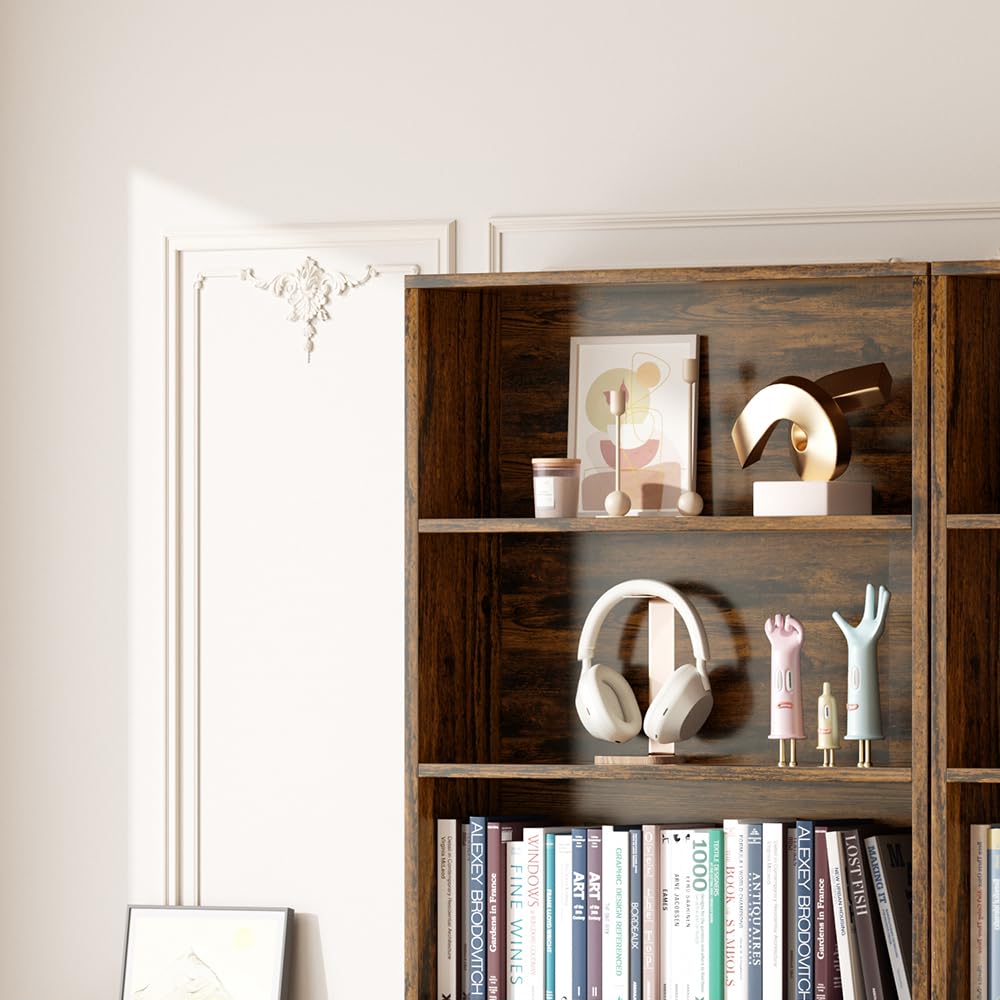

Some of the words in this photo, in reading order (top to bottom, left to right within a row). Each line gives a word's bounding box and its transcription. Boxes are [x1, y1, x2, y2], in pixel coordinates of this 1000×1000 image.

[470, 821, 484, 886] ALEXEY
[528, 834, 539, 908] WINDOWS
[692, 840, 708, 892] 1000
[798, 826, 810, 891] ALEXEY
[845, 835, 862, 877] LOST
[489, 873, 498, 900] France
[510, 864, 524, 909] FINE
[574, 872, 584, 900] ART
[589, 872, 600, 900] ART
[726, 866, 735, 904] BOOK
[816, 878, 824, 909] France
[868, 846, 884, 890] MAKING
[878, 892, 887, 904] IT
[489, 904, 498, 914] in
[752, 872, 760, 966] ANTIQUAIRES
[816, 912, 824, 921] in
[852, 880, 868, 916] FISH
[470, 889, 484, 996] BRODOVITCH
[489, 916, 498, 952] Gardens
[510, 919, 524, 985] WINES
[726, 920, 735, 987] SYMBOLS
[816, 922, 824, 960] Gardens
